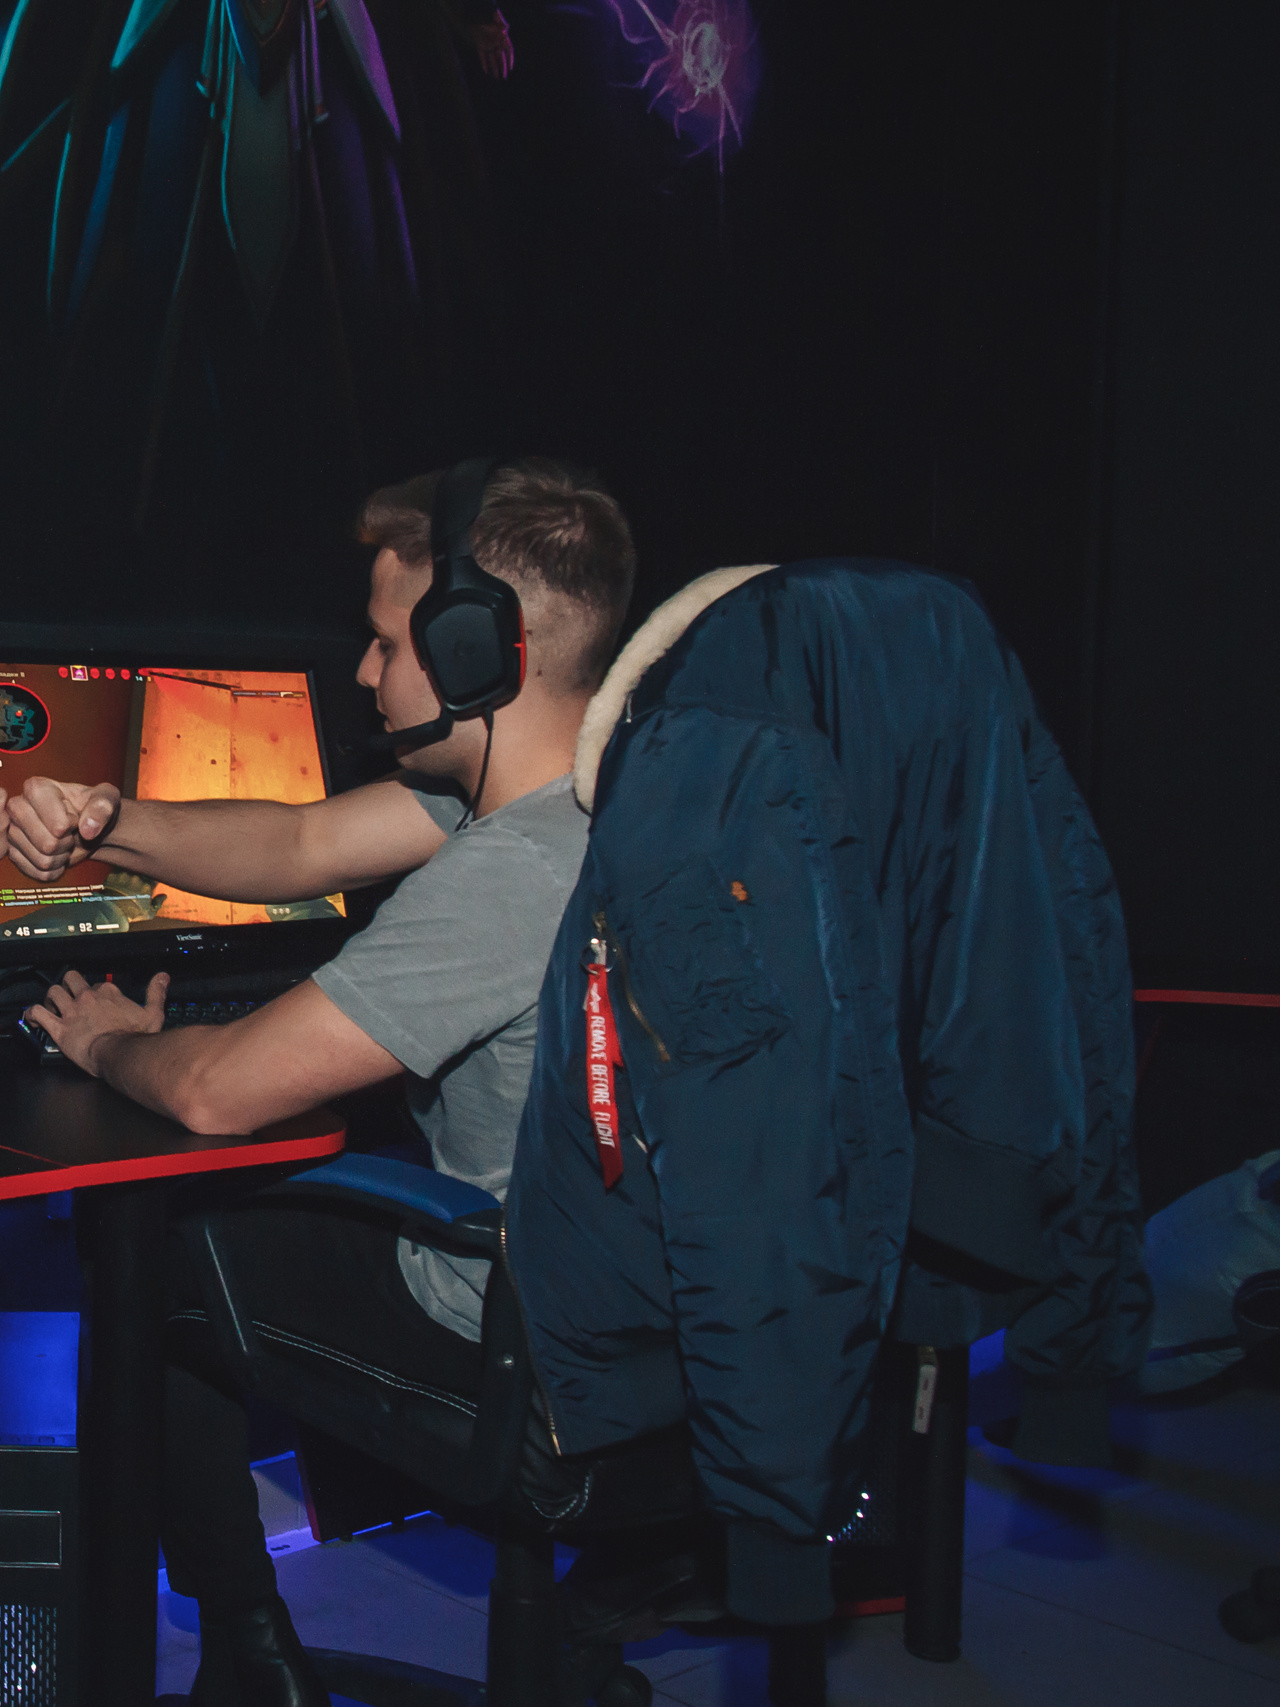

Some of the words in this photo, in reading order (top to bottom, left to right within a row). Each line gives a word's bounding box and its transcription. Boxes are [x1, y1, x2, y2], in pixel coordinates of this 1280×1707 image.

[16, 926, 30, 937] 46
[79, 922, 93, 933] 92
[176, 933, 203, 941] ViewSonic
[590, 1015, 608, 1061] REMOVE
[590, 1063, 611, 1106] BEFORE
[594, 1111, 616, 1149] FLIGHT
